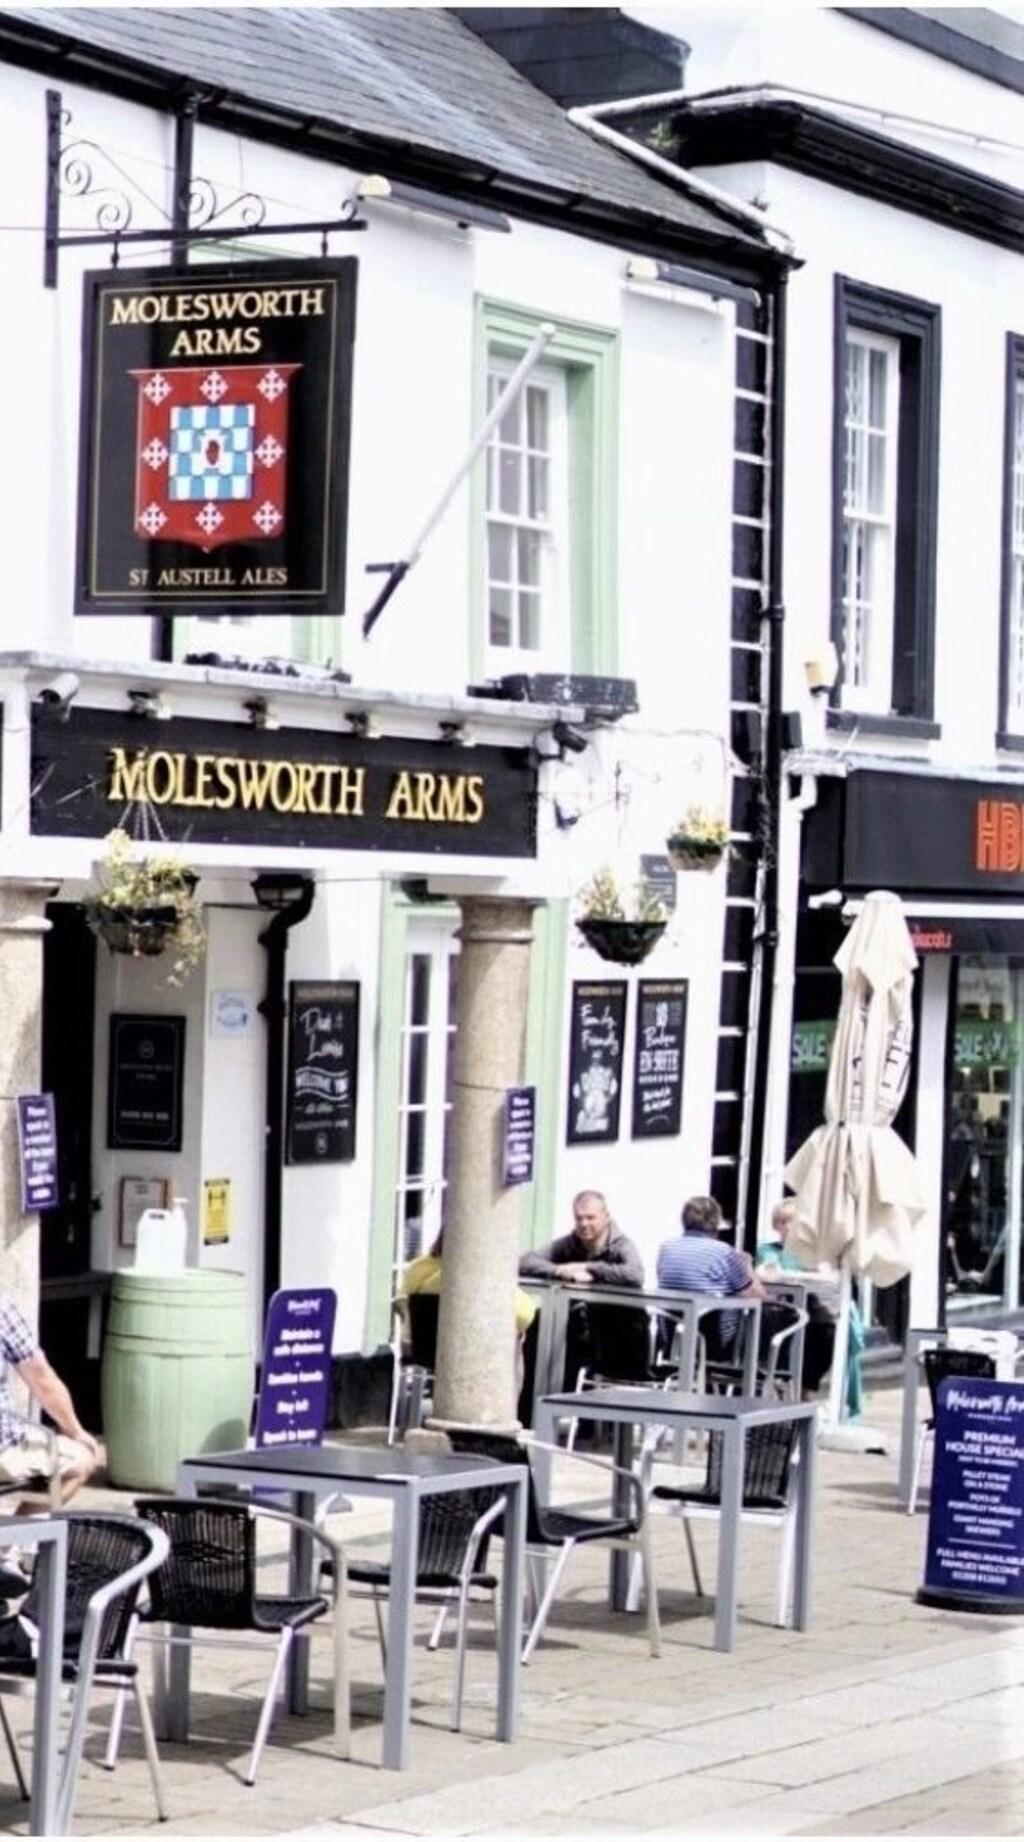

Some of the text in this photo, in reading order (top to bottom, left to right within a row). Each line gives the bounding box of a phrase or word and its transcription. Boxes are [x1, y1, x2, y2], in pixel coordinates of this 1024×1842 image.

[110, 288, 325, 325] MOLESWORTH
[170, 327, 261, 357] ARMS
[158, 567, 236, 586] AUSTELL
[241, 567, 289, 585] ALES
[107, 747, 484, 824] MOLESWORTH ARMS
